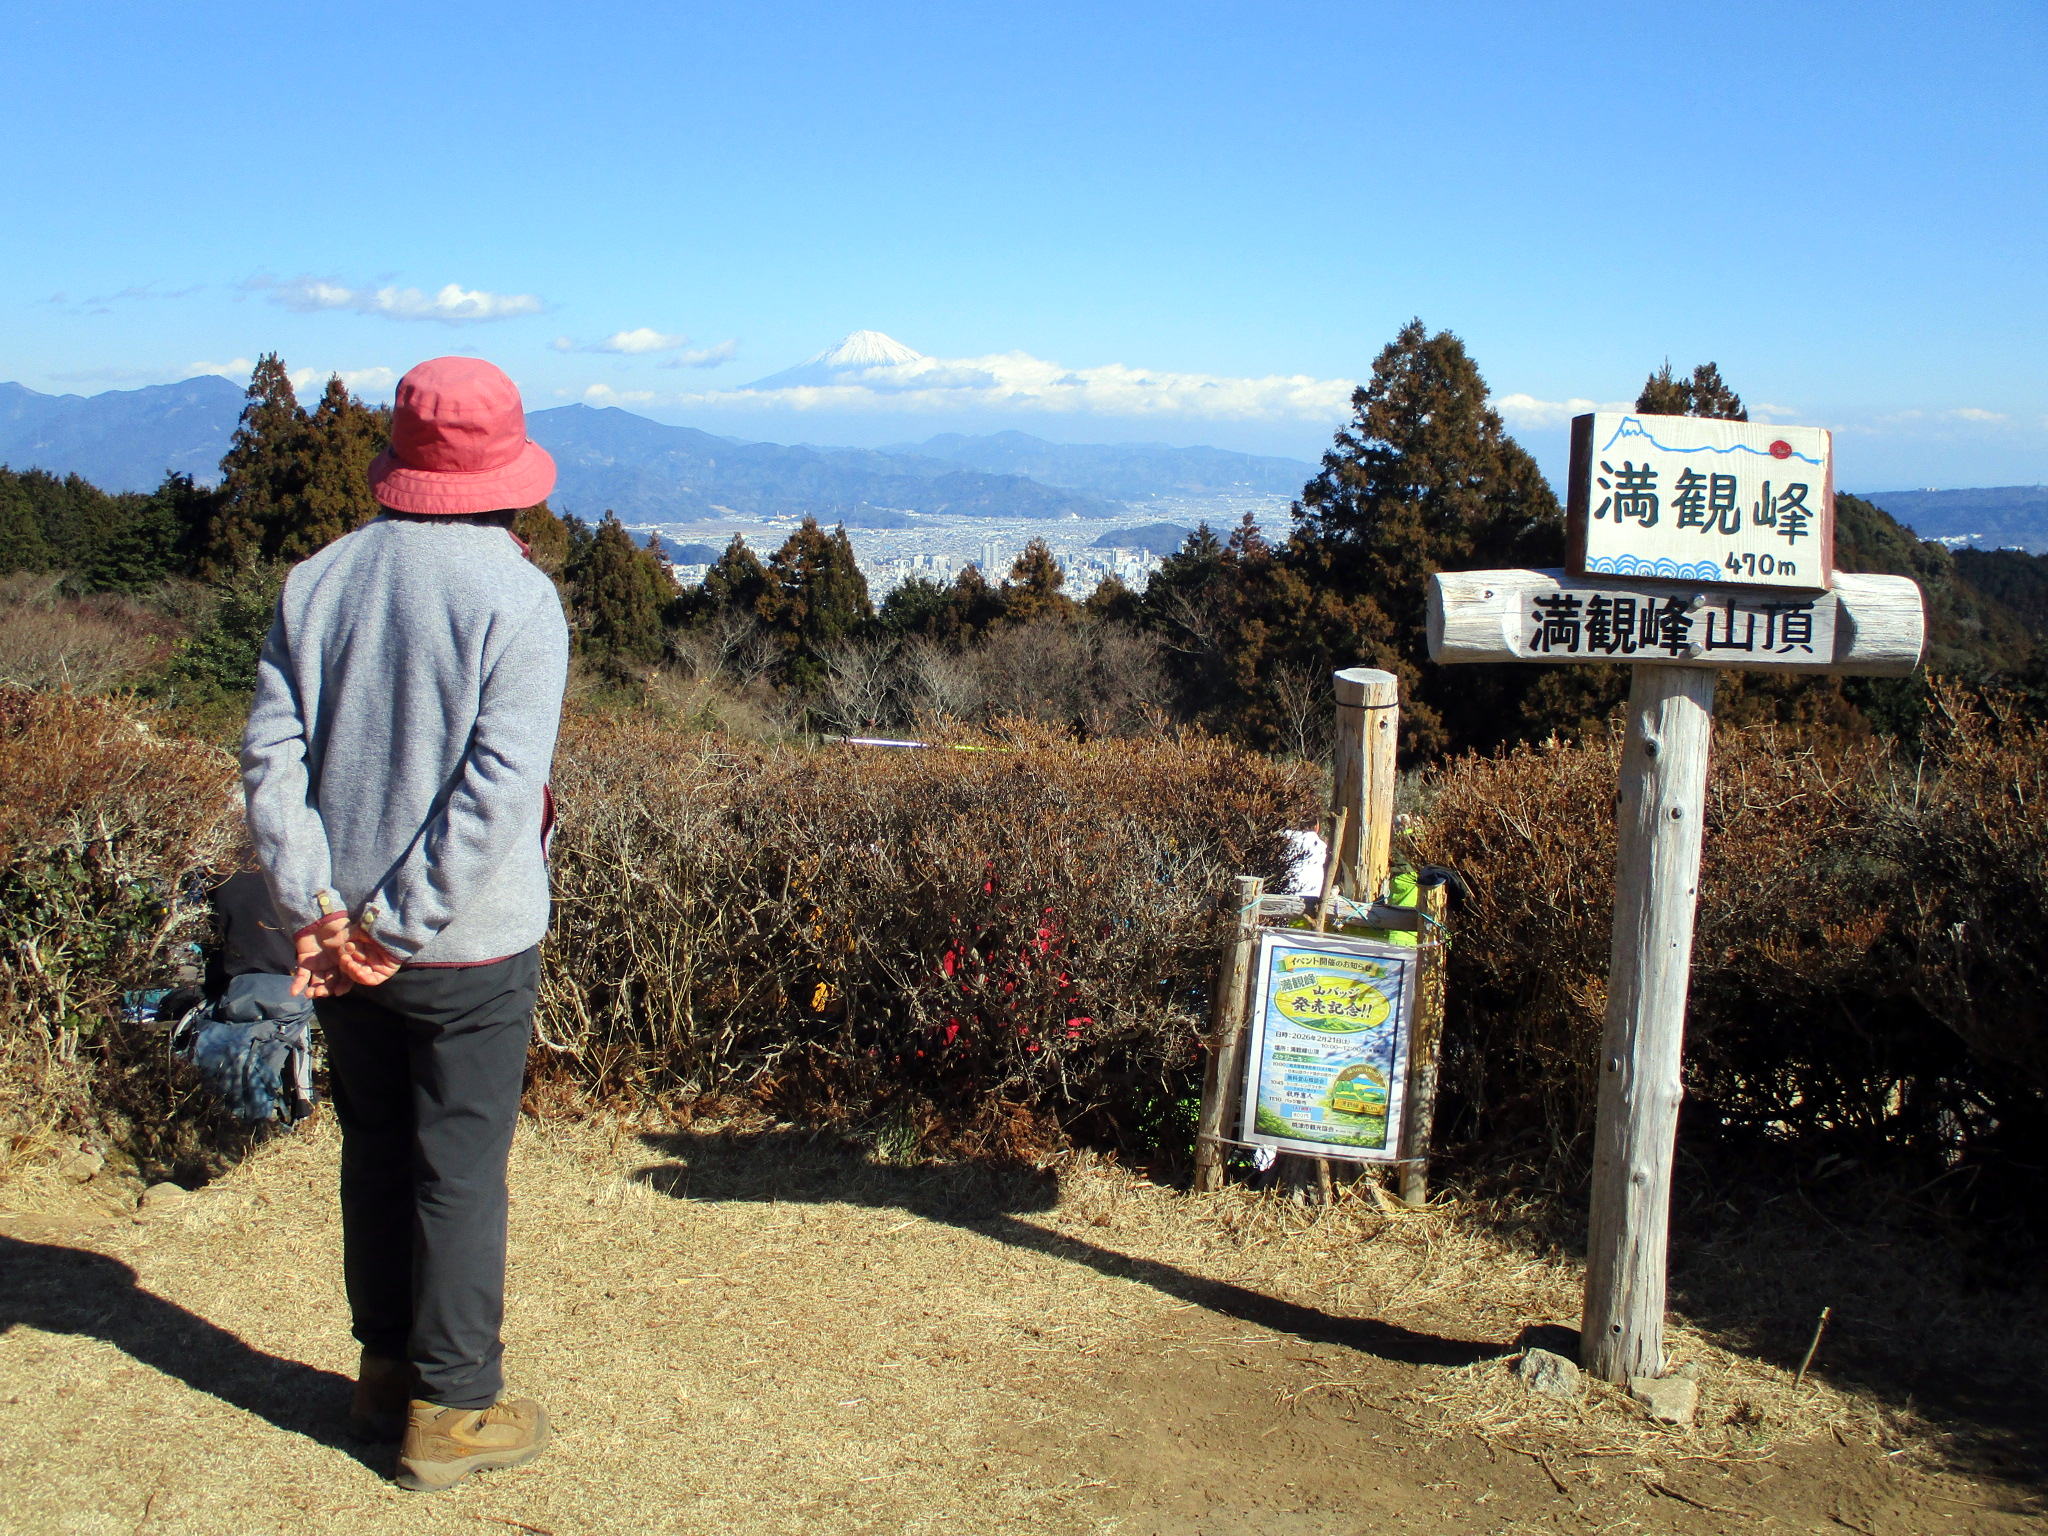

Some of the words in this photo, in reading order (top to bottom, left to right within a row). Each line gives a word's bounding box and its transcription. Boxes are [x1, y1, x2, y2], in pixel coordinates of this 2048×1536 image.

[1594, 460, 1814, 546] 満観峰
[1724, 551, 1796, 577] 470m
[1529, 593, 1815, 656] 満観峰山頂
[1291, 957, 1372, 972] イベント開催のお知らせ
[1280, 973, 1317, 991] 満観峰
[1313, 985, 1360, 1000] 山バッジ
